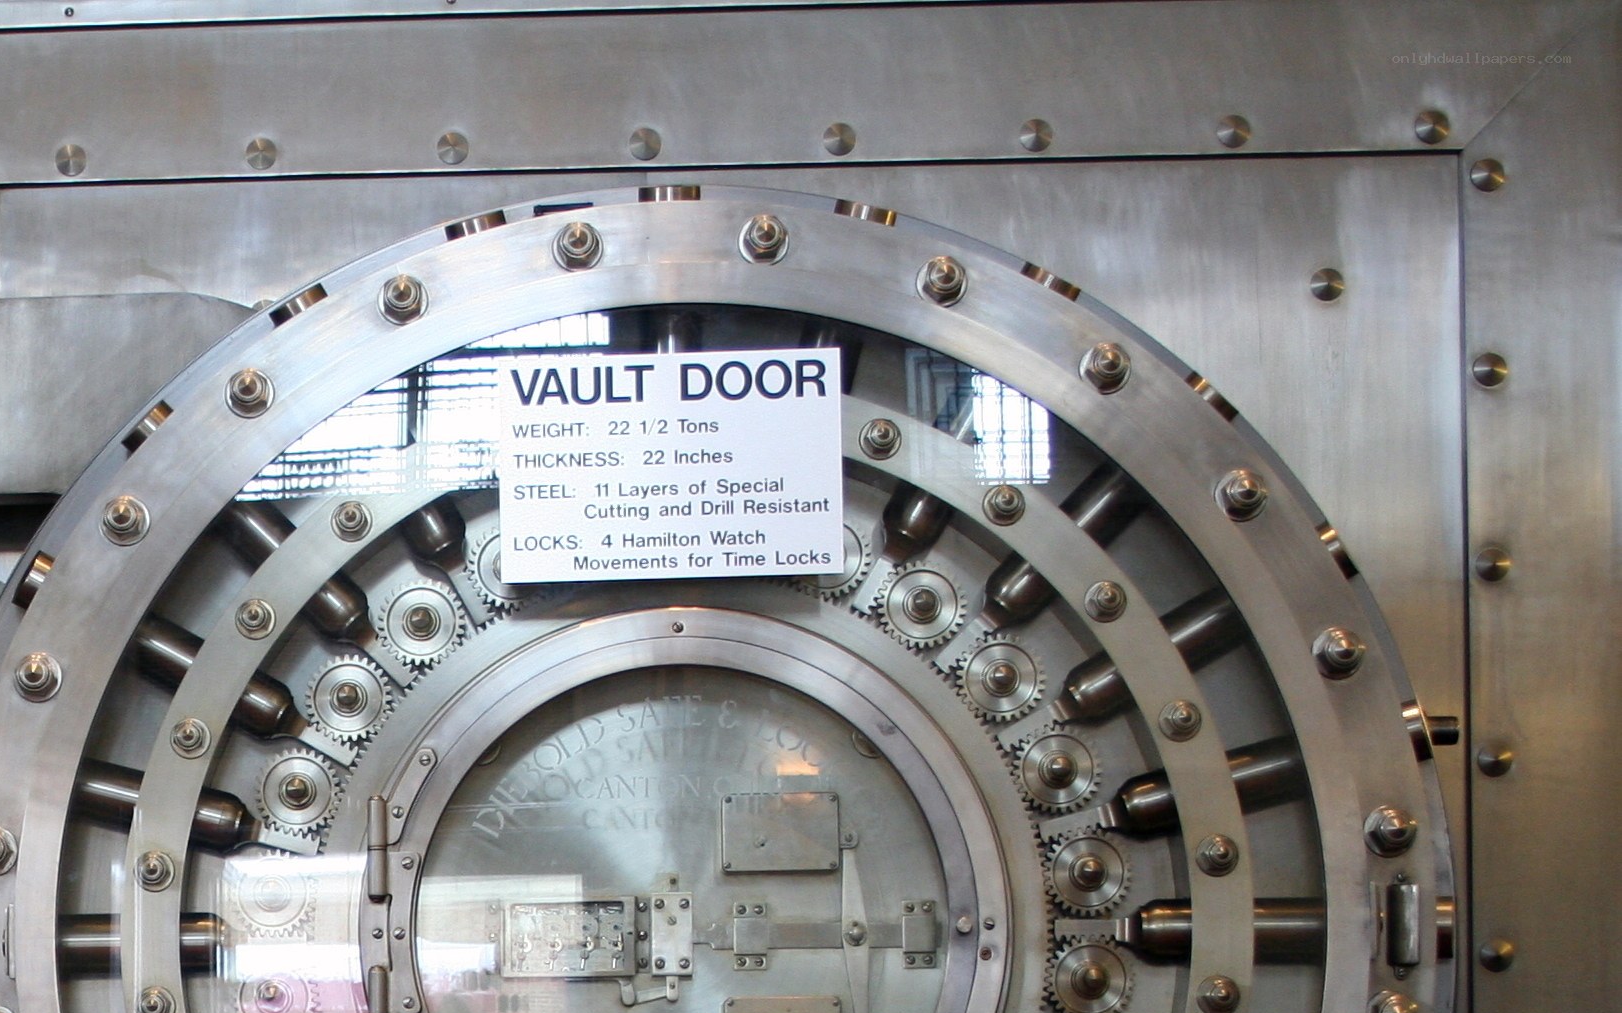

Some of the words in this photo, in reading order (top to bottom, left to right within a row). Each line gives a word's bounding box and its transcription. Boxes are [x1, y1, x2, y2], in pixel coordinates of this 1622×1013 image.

[510, 363, 655, 406] VAULT
[679, 359, 827, 401] DOOR
[512, 422, 590, 439] WEIGHT:
[608, 420, 631, 436] 22
[639, 418, 669, 435] 1/2
[677, 418, 720, 434] Tons
[513, 451, 625, 469] THICKNESS:
[642, 449, 666, 465] 22
[674, 448, 734, 465] Inches
[513, 484, 576, 500] STEEL:
[594, 482, 609, 498] 11
[618, 481, 679, 500] Layers
[688, 479, 707, 496] of
[716, 477, 784, 498] Special
[584, 503, 650, 521] Cutting
[659, 501, 692, 517] and
[701, 500, 735, 516] Drill
[743, 497, 830, 515] Resistant
[513, 535, 583, 551] LOCKS:
[601, 534, 613, 549] 4
[622, 531, 701, 549] Hamilton
[710, 529, 766, 546] Watch
[574, 553, 679, 571] Movements
[688, 552, 714, 568] for
[722, 551, 767, 567] Time
[775, 549, 832, 566] Locks
[472, 717, 606, 838] DIEBOLD
